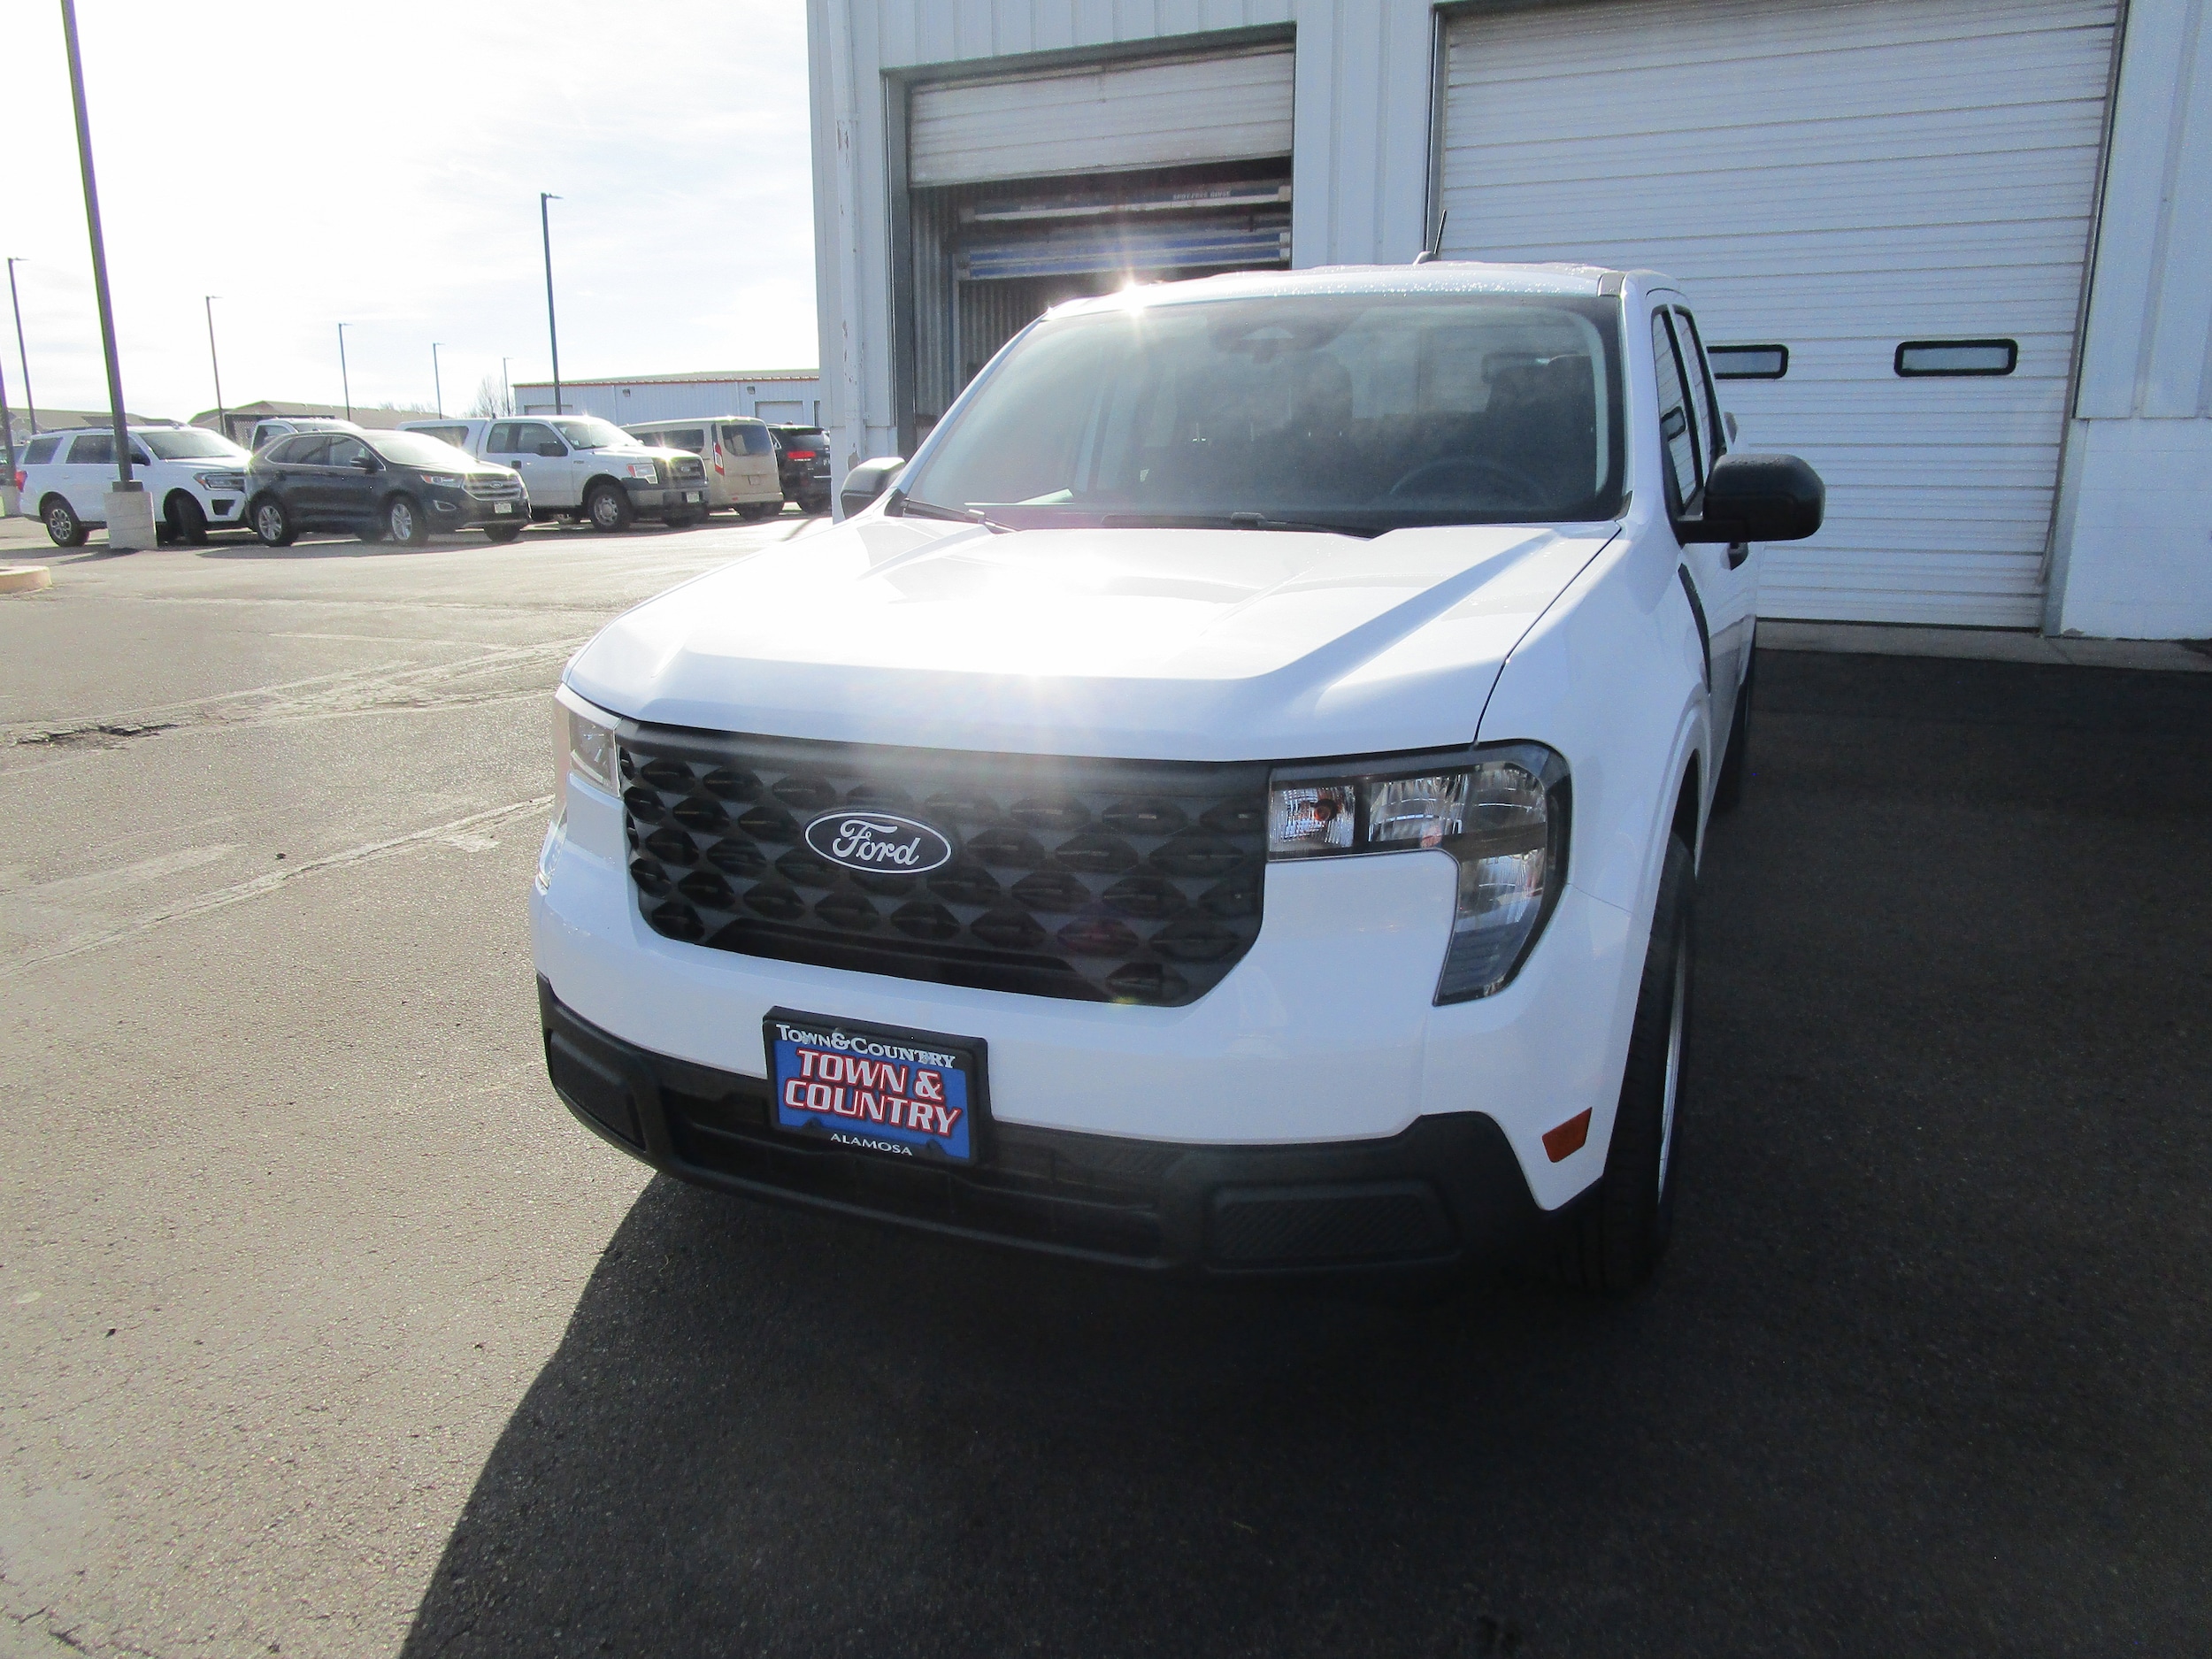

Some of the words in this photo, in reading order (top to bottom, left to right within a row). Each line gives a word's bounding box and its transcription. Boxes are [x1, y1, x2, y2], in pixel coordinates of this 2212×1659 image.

[833, 819, 921, 865] Ford
[797, 1048, 908, 1094] TOWN
[913, 1069, 944, 1102] &
[784, 1079, 961, 1136] COUNTRY
[830, 1133, 913, 1156] ALAMOSA
